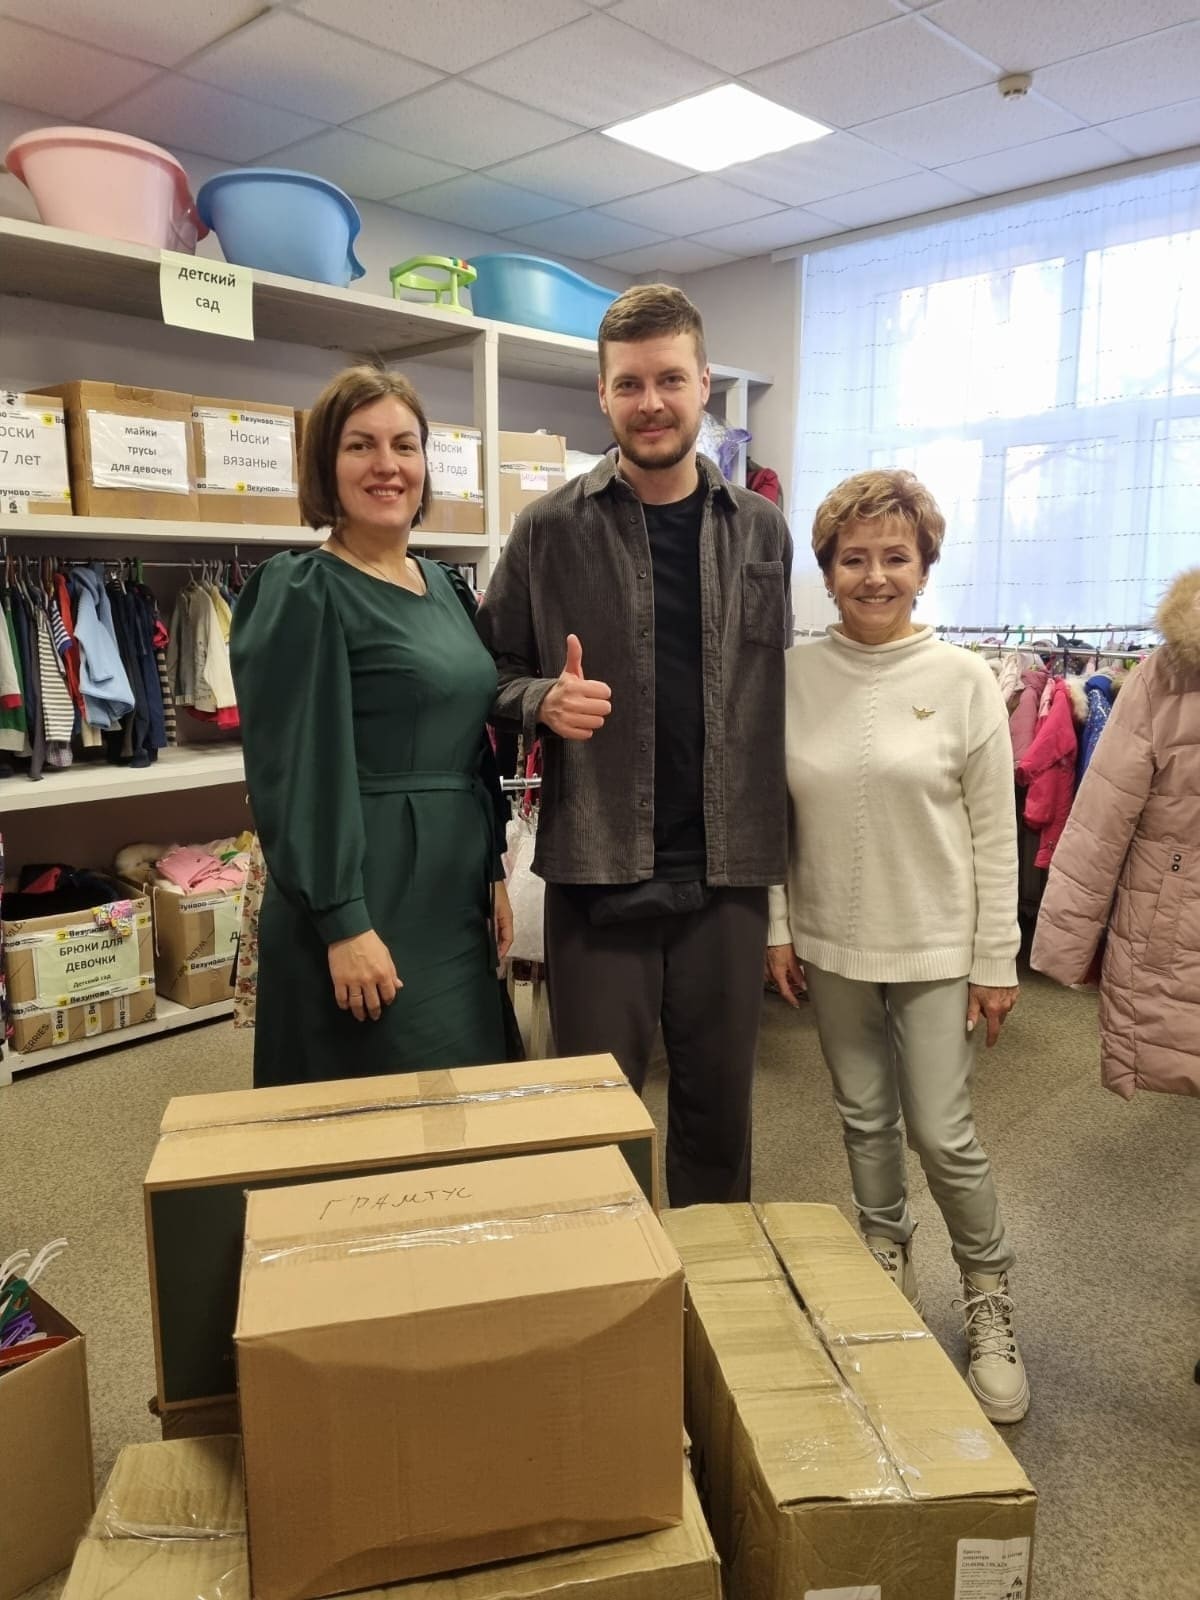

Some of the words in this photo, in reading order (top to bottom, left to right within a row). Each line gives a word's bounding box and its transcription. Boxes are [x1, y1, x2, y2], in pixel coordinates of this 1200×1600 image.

[178, 267, 236, 287] детский
[195, 296, 221, 313] сад
[125, 426, 157, 437] майки
[230, 429, 270, 445] Носки
[128, 446, 157, 456] трусы
[433, 441, 463, 454] Носки
[14, 454, 41, 466] лет
[223, 455, 278, 469] вязаные
[110, 463, 130, 472] для
[133, 464, 173, 475] девочек
[446, 464, 468, 476] года
[59, 940, 99, 957] БРЮКИ
[101, 936, 123, 950] ДЛЯ
[65, 955, 116, 974] ДЕВОЧКИ
